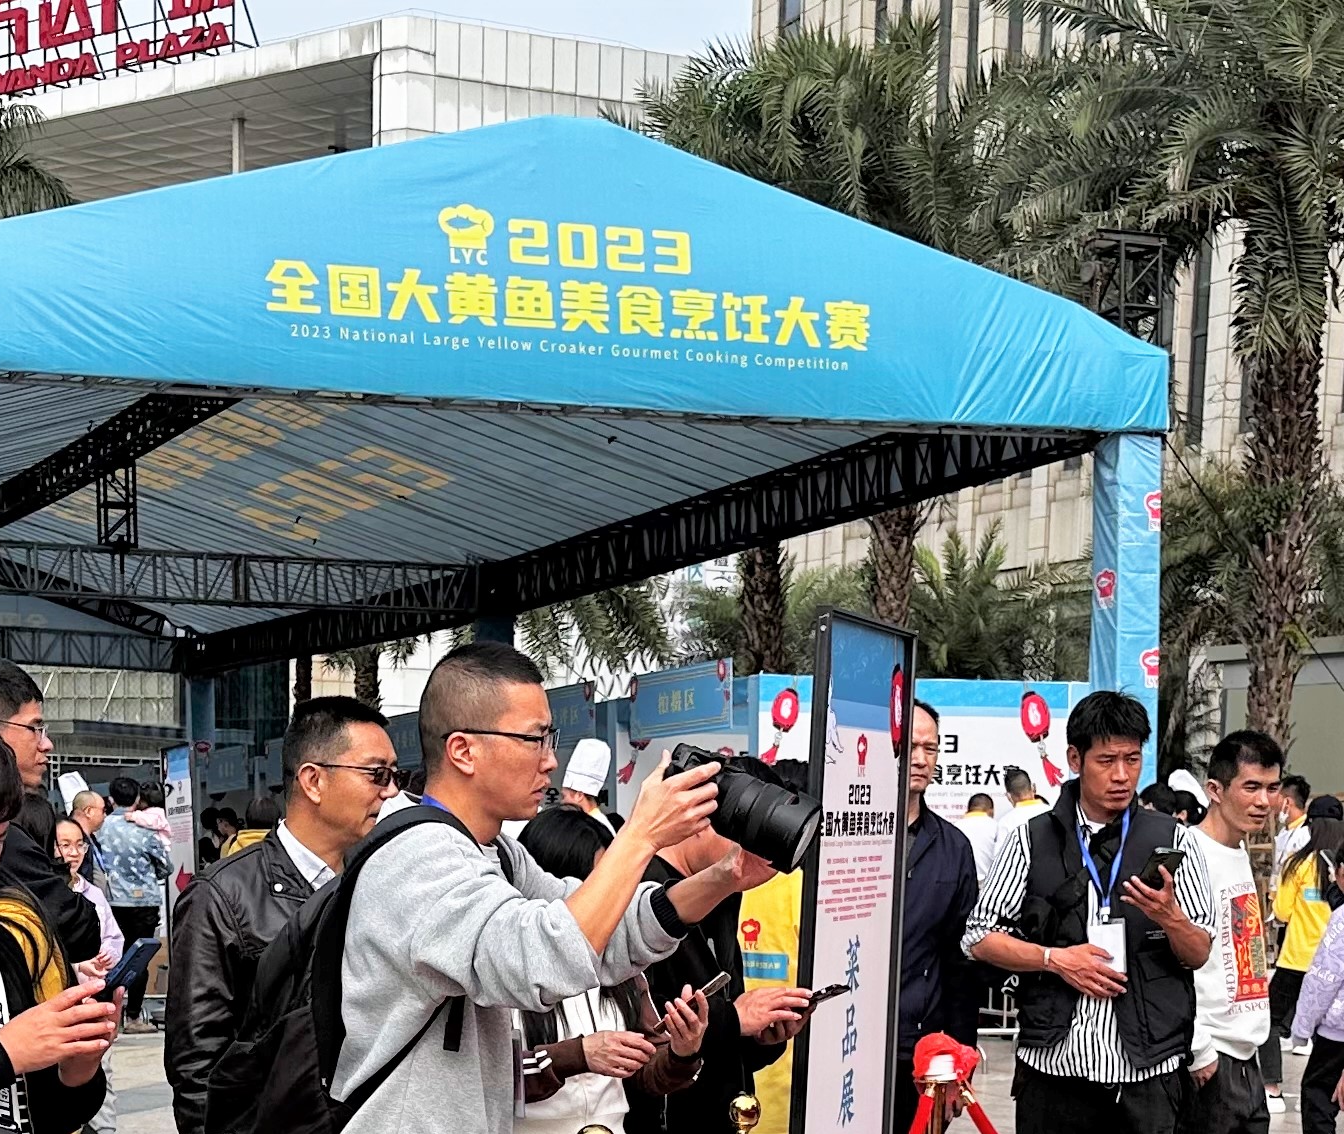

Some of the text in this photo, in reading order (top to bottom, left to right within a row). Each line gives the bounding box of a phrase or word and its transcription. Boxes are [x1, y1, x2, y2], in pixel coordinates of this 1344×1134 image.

[116, 22, 231, 69] PLAZA
[449, 248, 488, 266] LYC
[507, 218, 692, 275] 2023
[264, 259, 871, 352] 全国大黄鱼美食烹饪大赛
[290, 323, 849, 371] 2023 National Large Yellow Croaker Gourmet Cooking Competition
[848, 784, 872, 805] 2023
[743, 942, 759, 950] LYC
